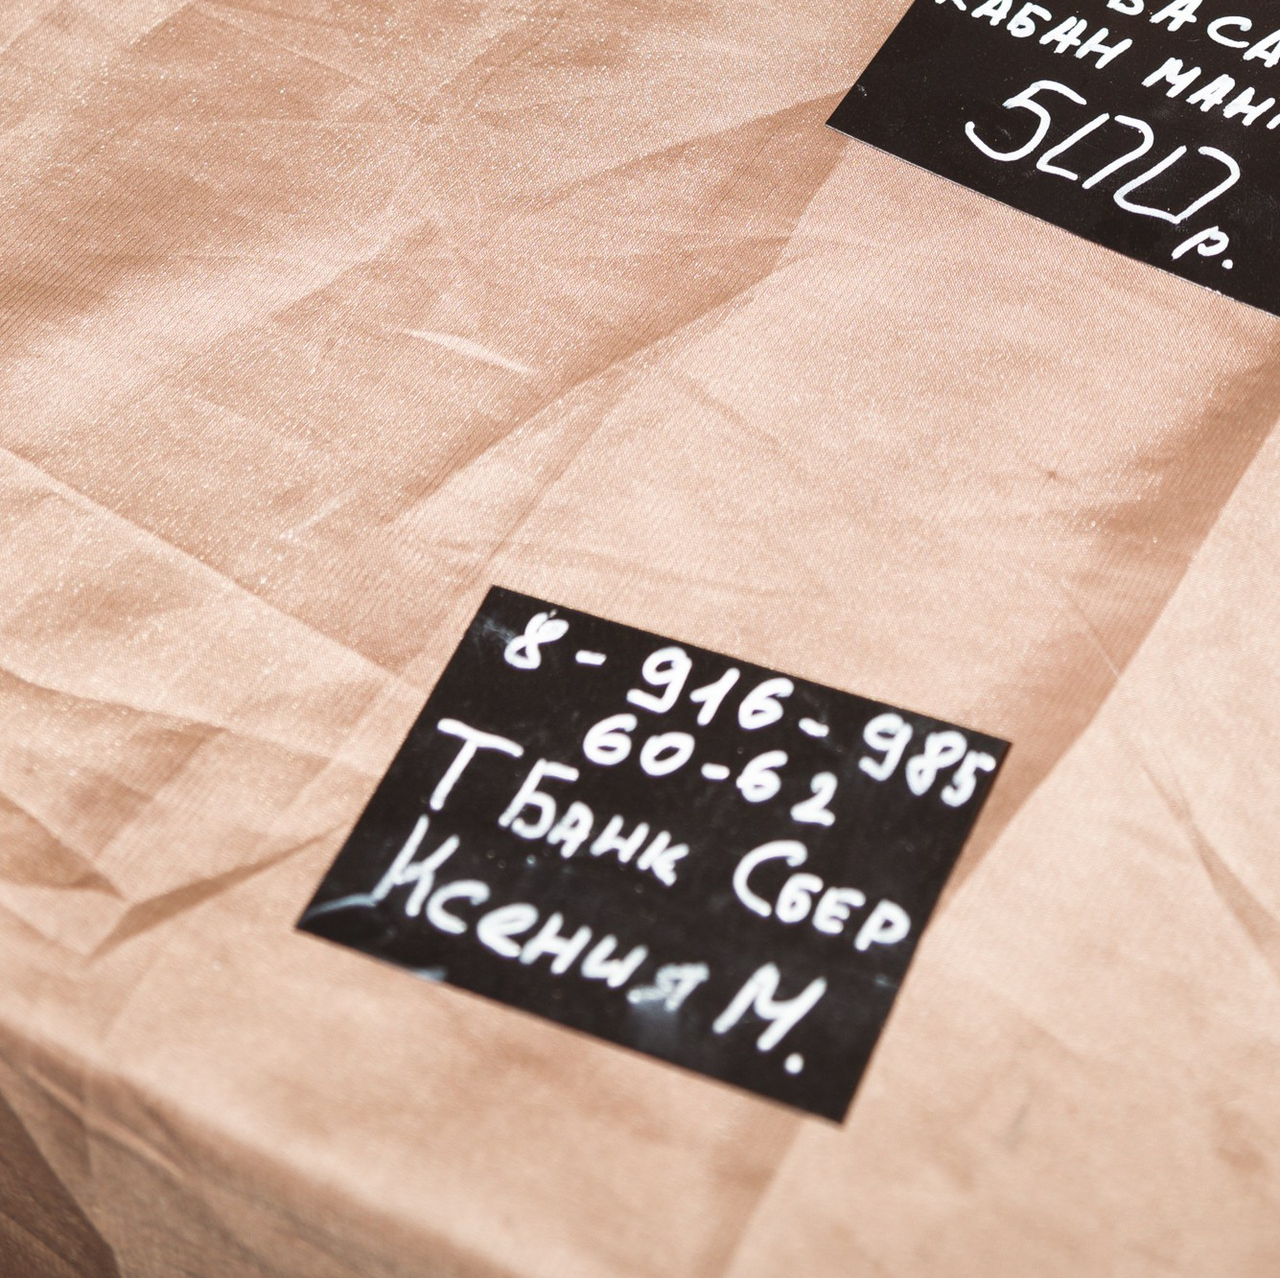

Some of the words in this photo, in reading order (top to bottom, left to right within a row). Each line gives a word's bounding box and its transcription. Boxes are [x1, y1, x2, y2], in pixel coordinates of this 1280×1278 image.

[964, 79, 1241, 225] 500
[372, 814, 709, 1013] Ксения
[712, 963, 804, 1074] М.
